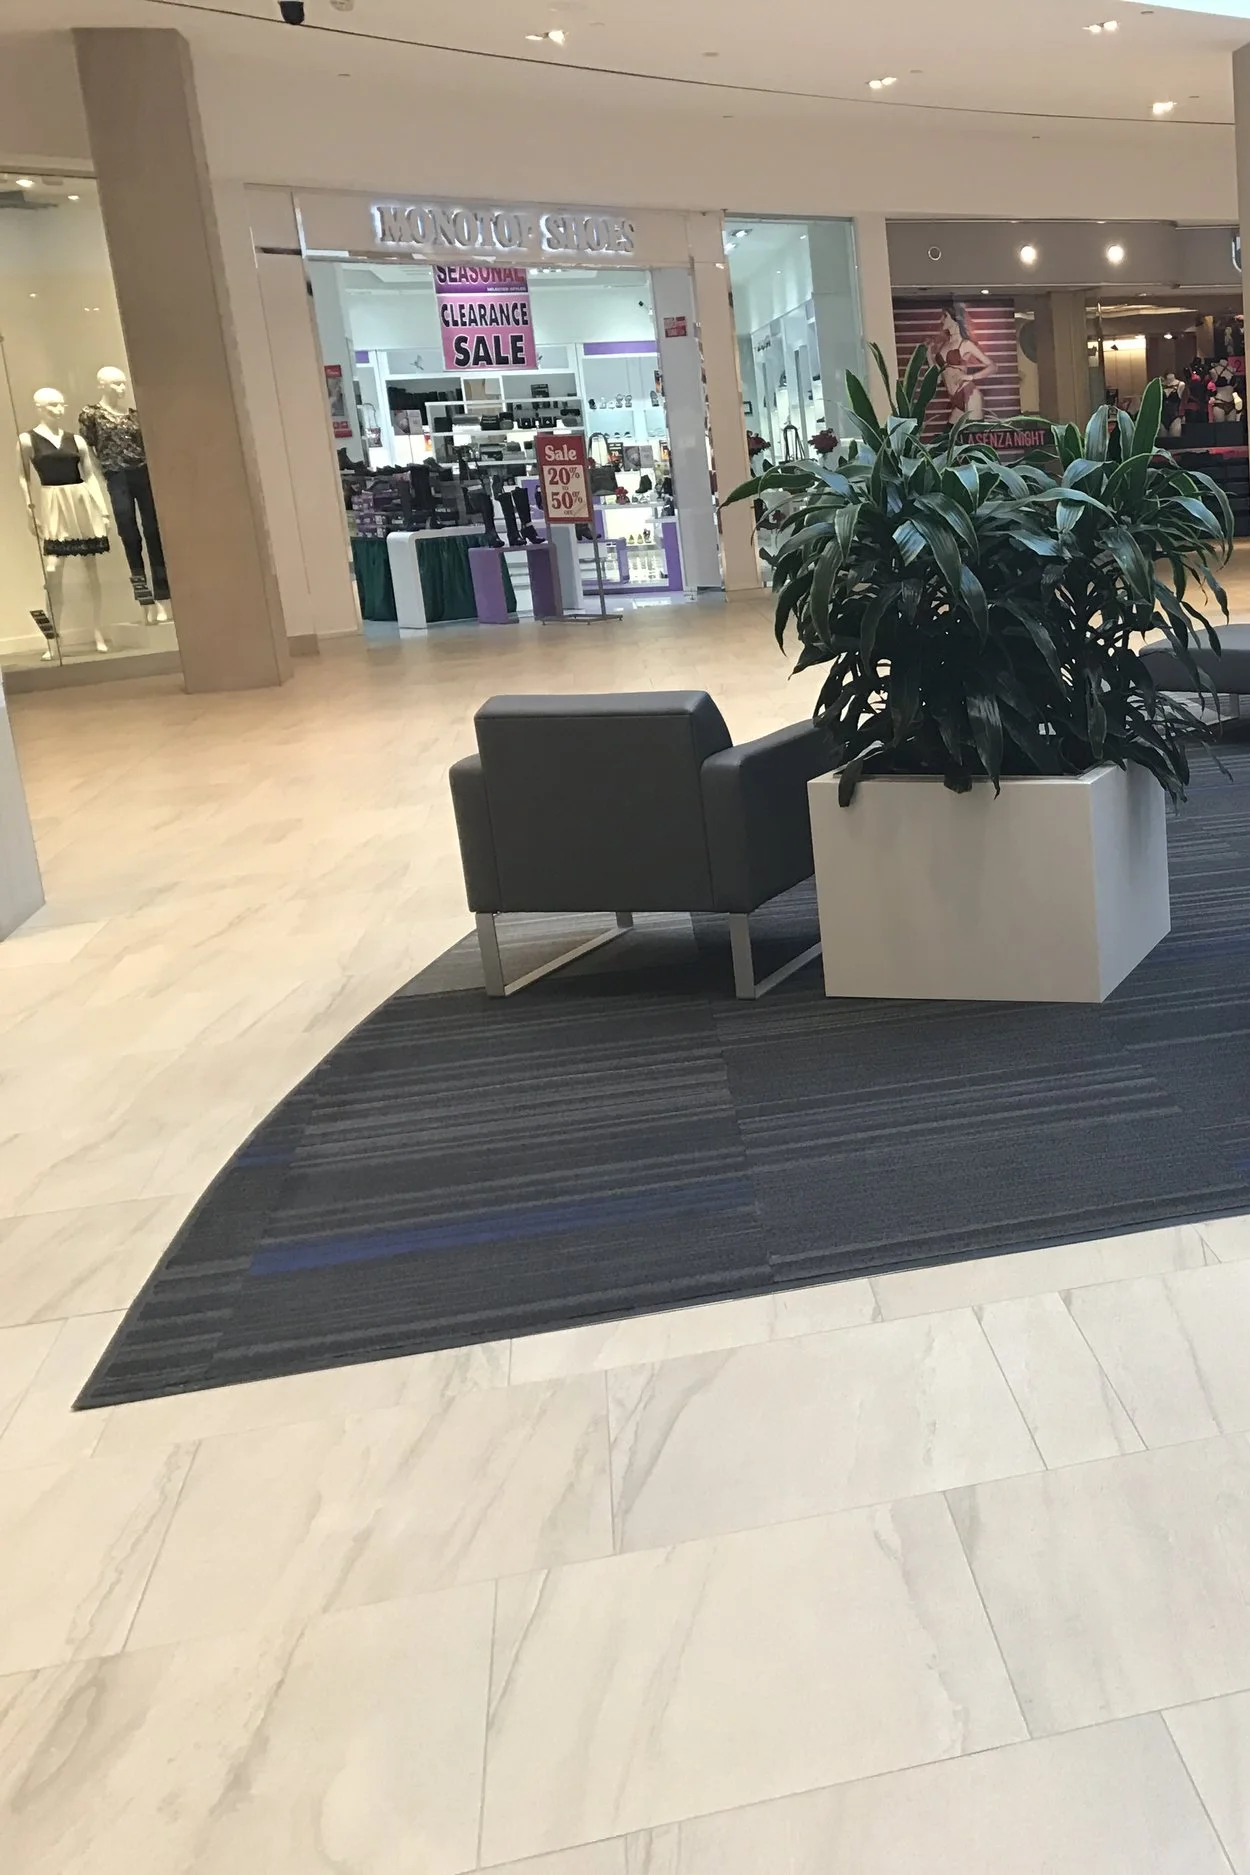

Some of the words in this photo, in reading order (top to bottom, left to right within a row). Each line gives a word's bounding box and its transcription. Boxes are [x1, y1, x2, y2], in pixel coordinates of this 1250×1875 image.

[541, 214, 635, 253] SHOES
[436, 265, 525, 283] SEASONAL
[440, 302, 529, 328] CLEARANCE
[453, 334, 527, 367] SALE
[975, 431, 1013, 448] SENZA
[1013, 430, 1046, 447] NIGHT
[544, 444, 577, 461] Sale
[547, 466, 580, 486] 20%
[551, 490, 583, 510] 50%
